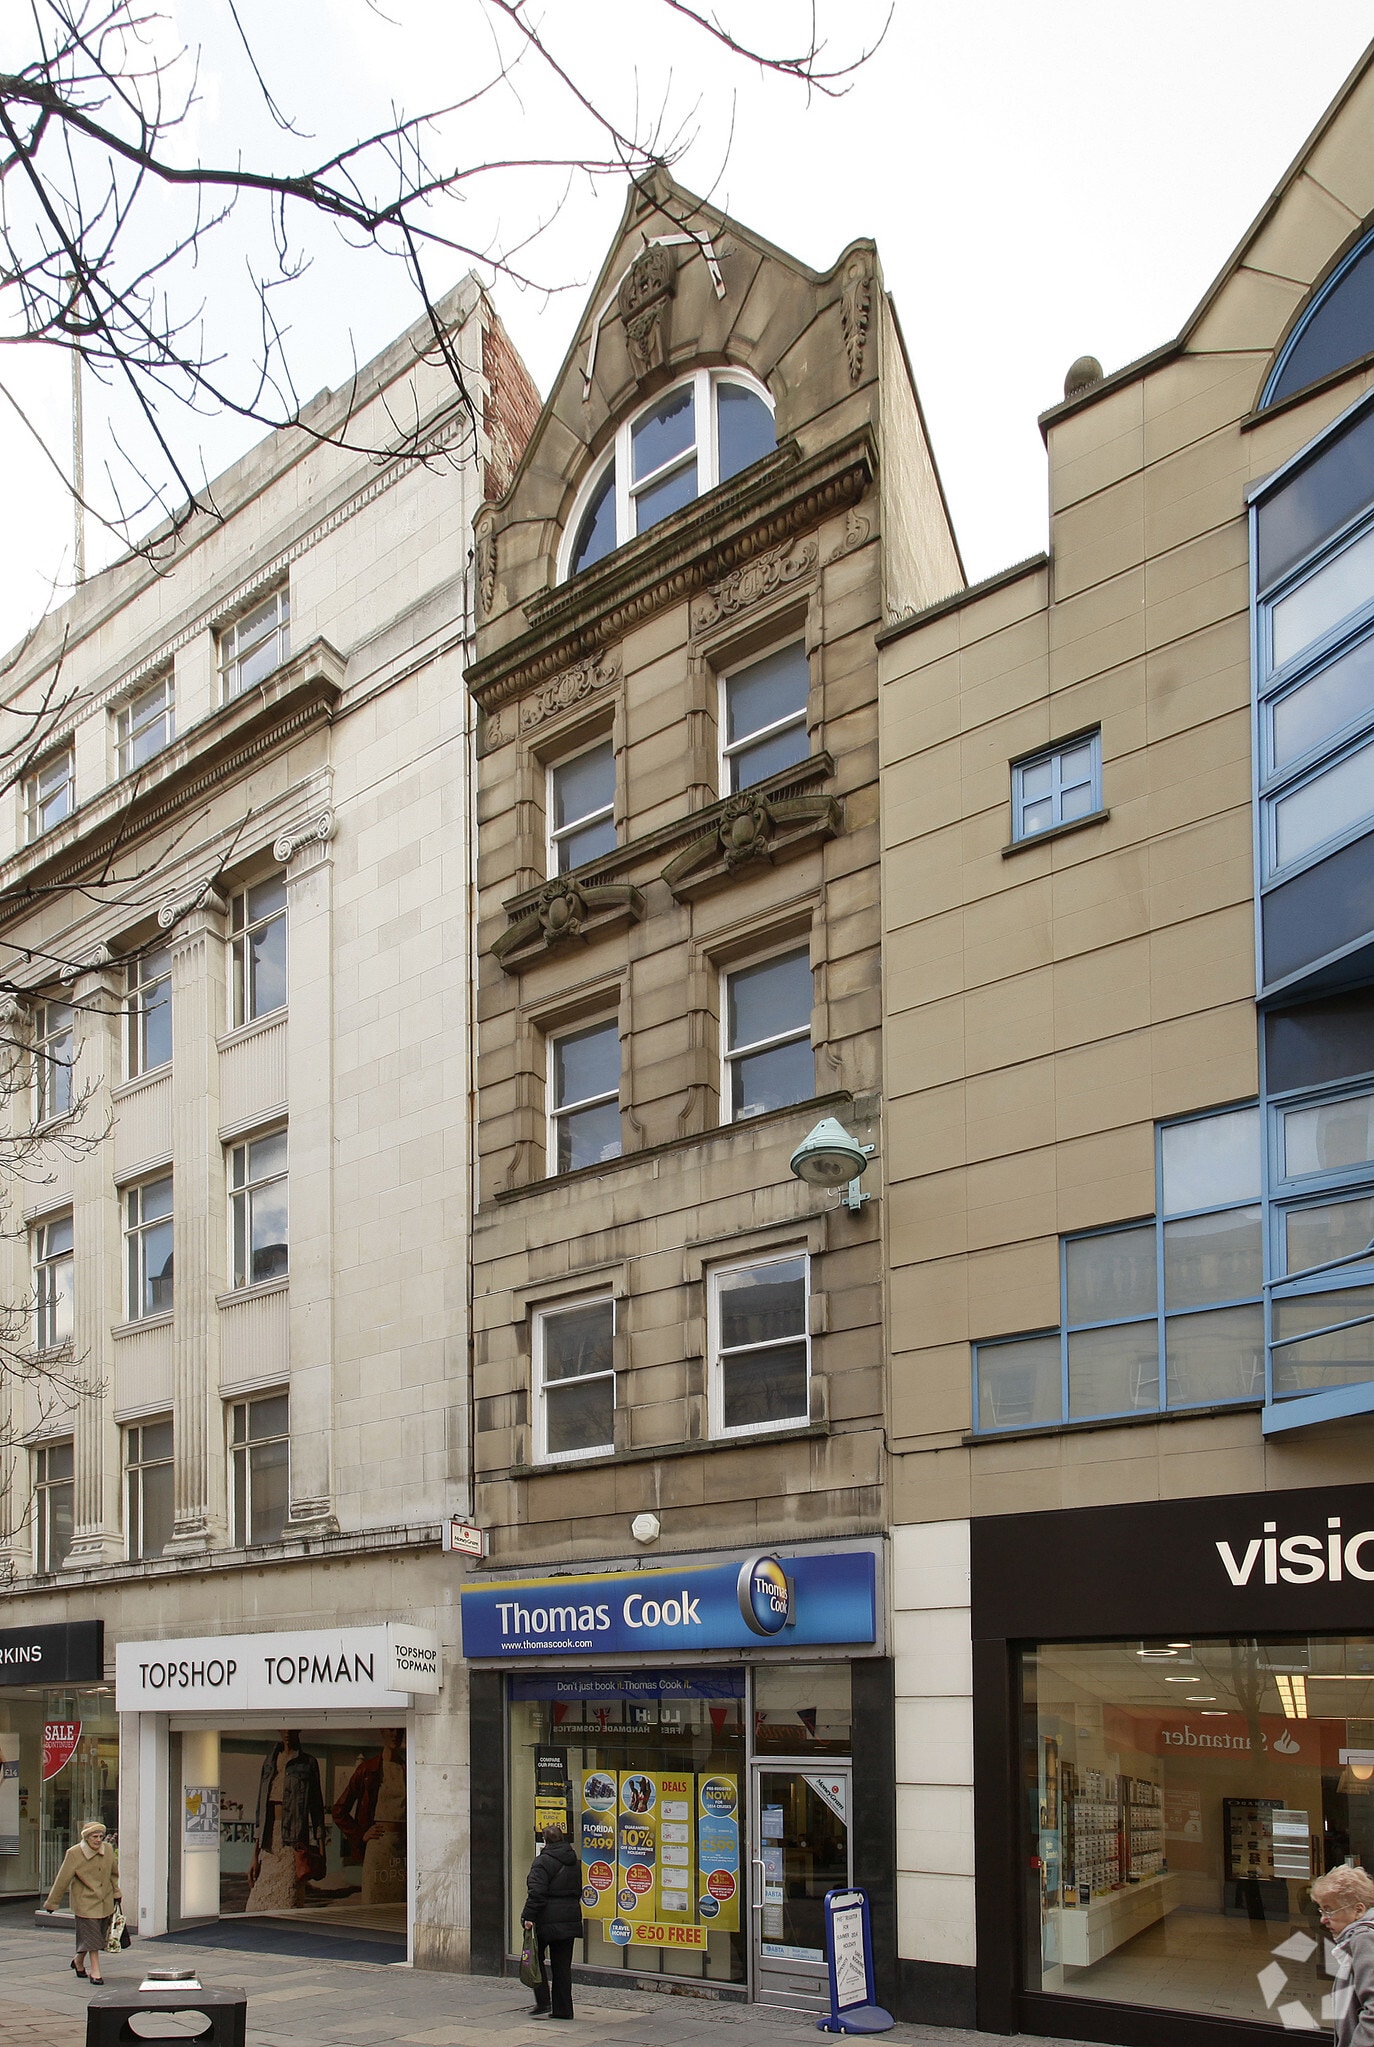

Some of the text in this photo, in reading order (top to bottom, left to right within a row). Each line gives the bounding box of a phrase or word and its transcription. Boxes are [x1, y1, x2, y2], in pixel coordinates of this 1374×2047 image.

[754, 1577, 788, 1600] Thomas
[770, 1596, 787, 1614] Cook
[496, 1590, 702, 1634] Thomas Cook
[501, 1638, 593, 1650] www.thomascook.com
[395, 1645, 437, 1660] TOPSHOP
[139, 1653, 374, 1689] TOPSHOP TOPMAN
[396, 1658, 436, 1673] TOPMAN
[557, 1681, 578, 1691] Don't
[578, 1681, 593, 1692] just
[595, 1680, 615, 1690] book
[659, 1679, 681, 1690] Cook
[45, 1725, 74, 1741] SALE
[4, 1769, 18, 1777] £14
[662, 1781, 687, 1792] DEALS
[705, 1791, 732, 1800] NOW
[815, 1779, 844, 1810] MoneyGram
[583, 1824, 614, 1834] FLORIDA
[583, 1837, 614, 1850] £499
[620, 1829, 653, 1847] 10%
[701, 1839, 735, 1853] £599
[592, 1865, 599, 1875] 3
[630, 1868, 637, 1878] 3
[713, 1873, 719, 1884] 3
[584, 1889, 596, 1899] 0%
[621, 1893, 635, 1902] 0%
[767, 1890, 782, 1898] ABTA
[636, 1925, 665, 1941] €50
[668, 1927, 702, 1943] FREE
